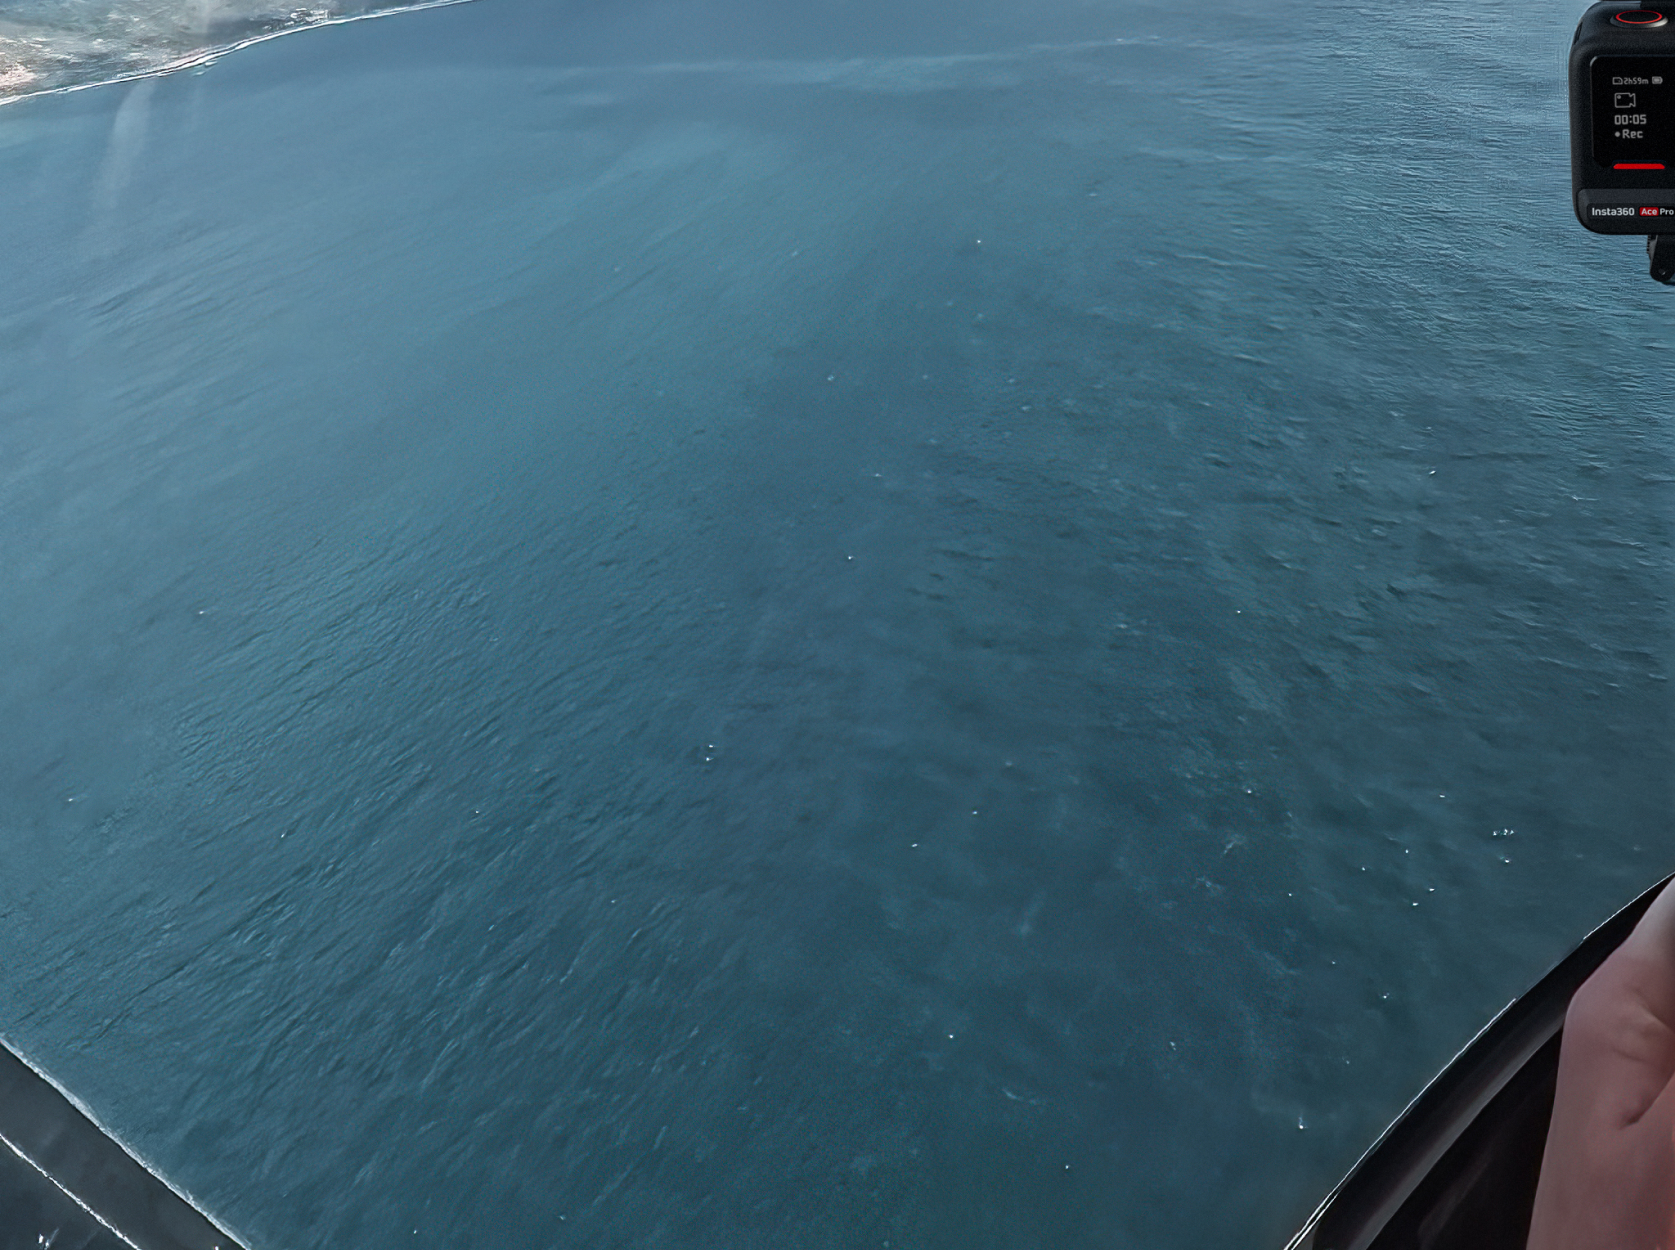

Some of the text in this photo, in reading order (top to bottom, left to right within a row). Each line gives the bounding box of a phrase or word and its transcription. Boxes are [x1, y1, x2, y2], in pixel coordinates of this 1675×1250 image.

[1623, 76, 1649, 85] 2h59m
[1614, 113, 1647, 125] 00:05
[1622, 128, 1644, 139] Rec
[1591, 207, 1635, 216] Insta360
[1641, 207, 1658, 216] Ace
[1659, 207, 1675, 216] Pro
